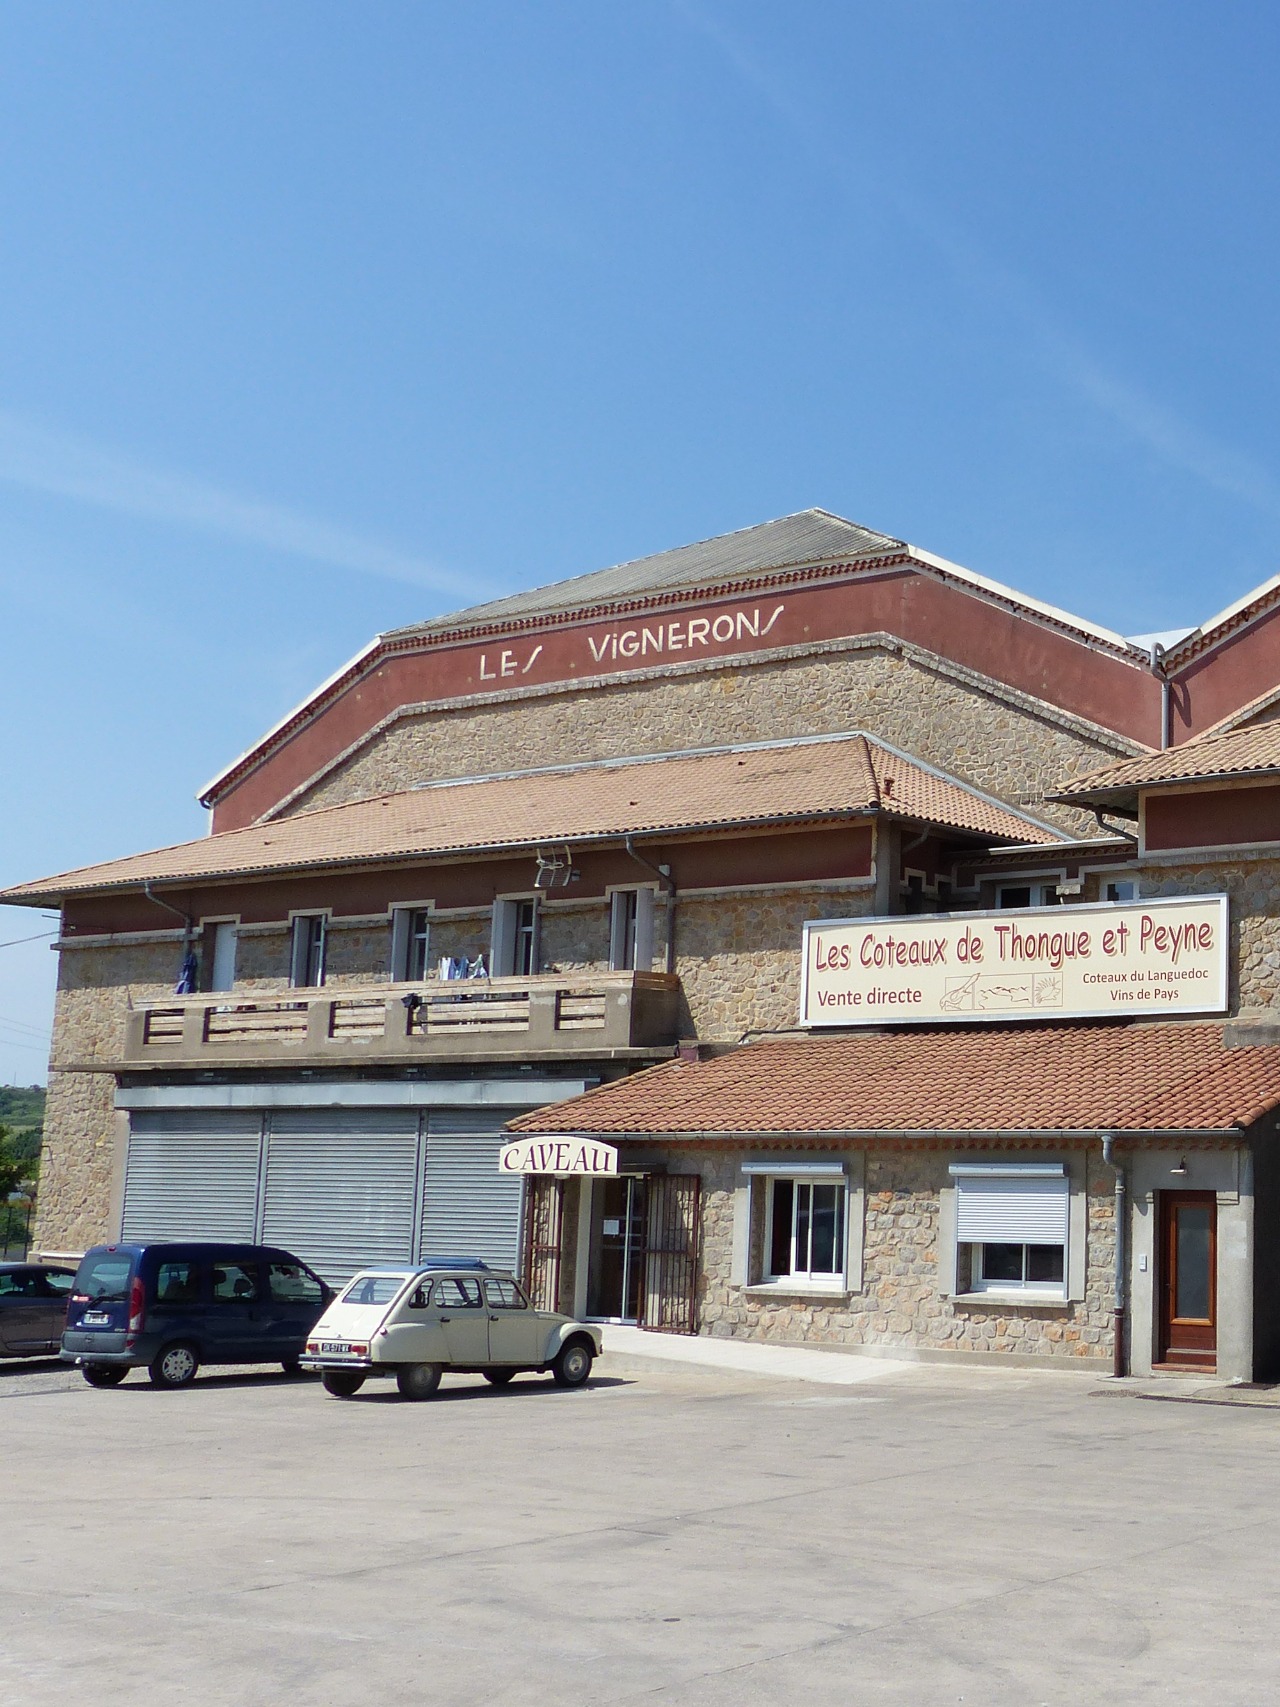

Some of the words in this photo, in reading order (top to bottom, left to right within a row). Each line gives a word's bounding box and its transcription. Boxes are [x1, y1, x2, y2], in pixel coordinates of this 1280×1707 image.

[479, 645, 543, 680] LES
[815, 935, 850, 970] Les
[859, 932, 947, 967] Coteaux
[956, 925, 983, 962] de
[993, 922, 1091, 968] Thongue
[1102, 920, 1129, 955] et
[1140, 914, 1213, 963] Peyne
[1082, 972, 1128, 984] Coteaux
[1130, 970, 1145, 982] du
[1147, 967, 1209, 983] Languedoc
[817, 987, 862, 1007] Vente
[866, 986, 922, 1005] directe
[1109, 988, 1135, 1001] Vins
[1137, 987, 1151, 1000] de
[1154, 987, 1180, 1002] Pays
[503, 1142, 612, 1172] CAVEAU
